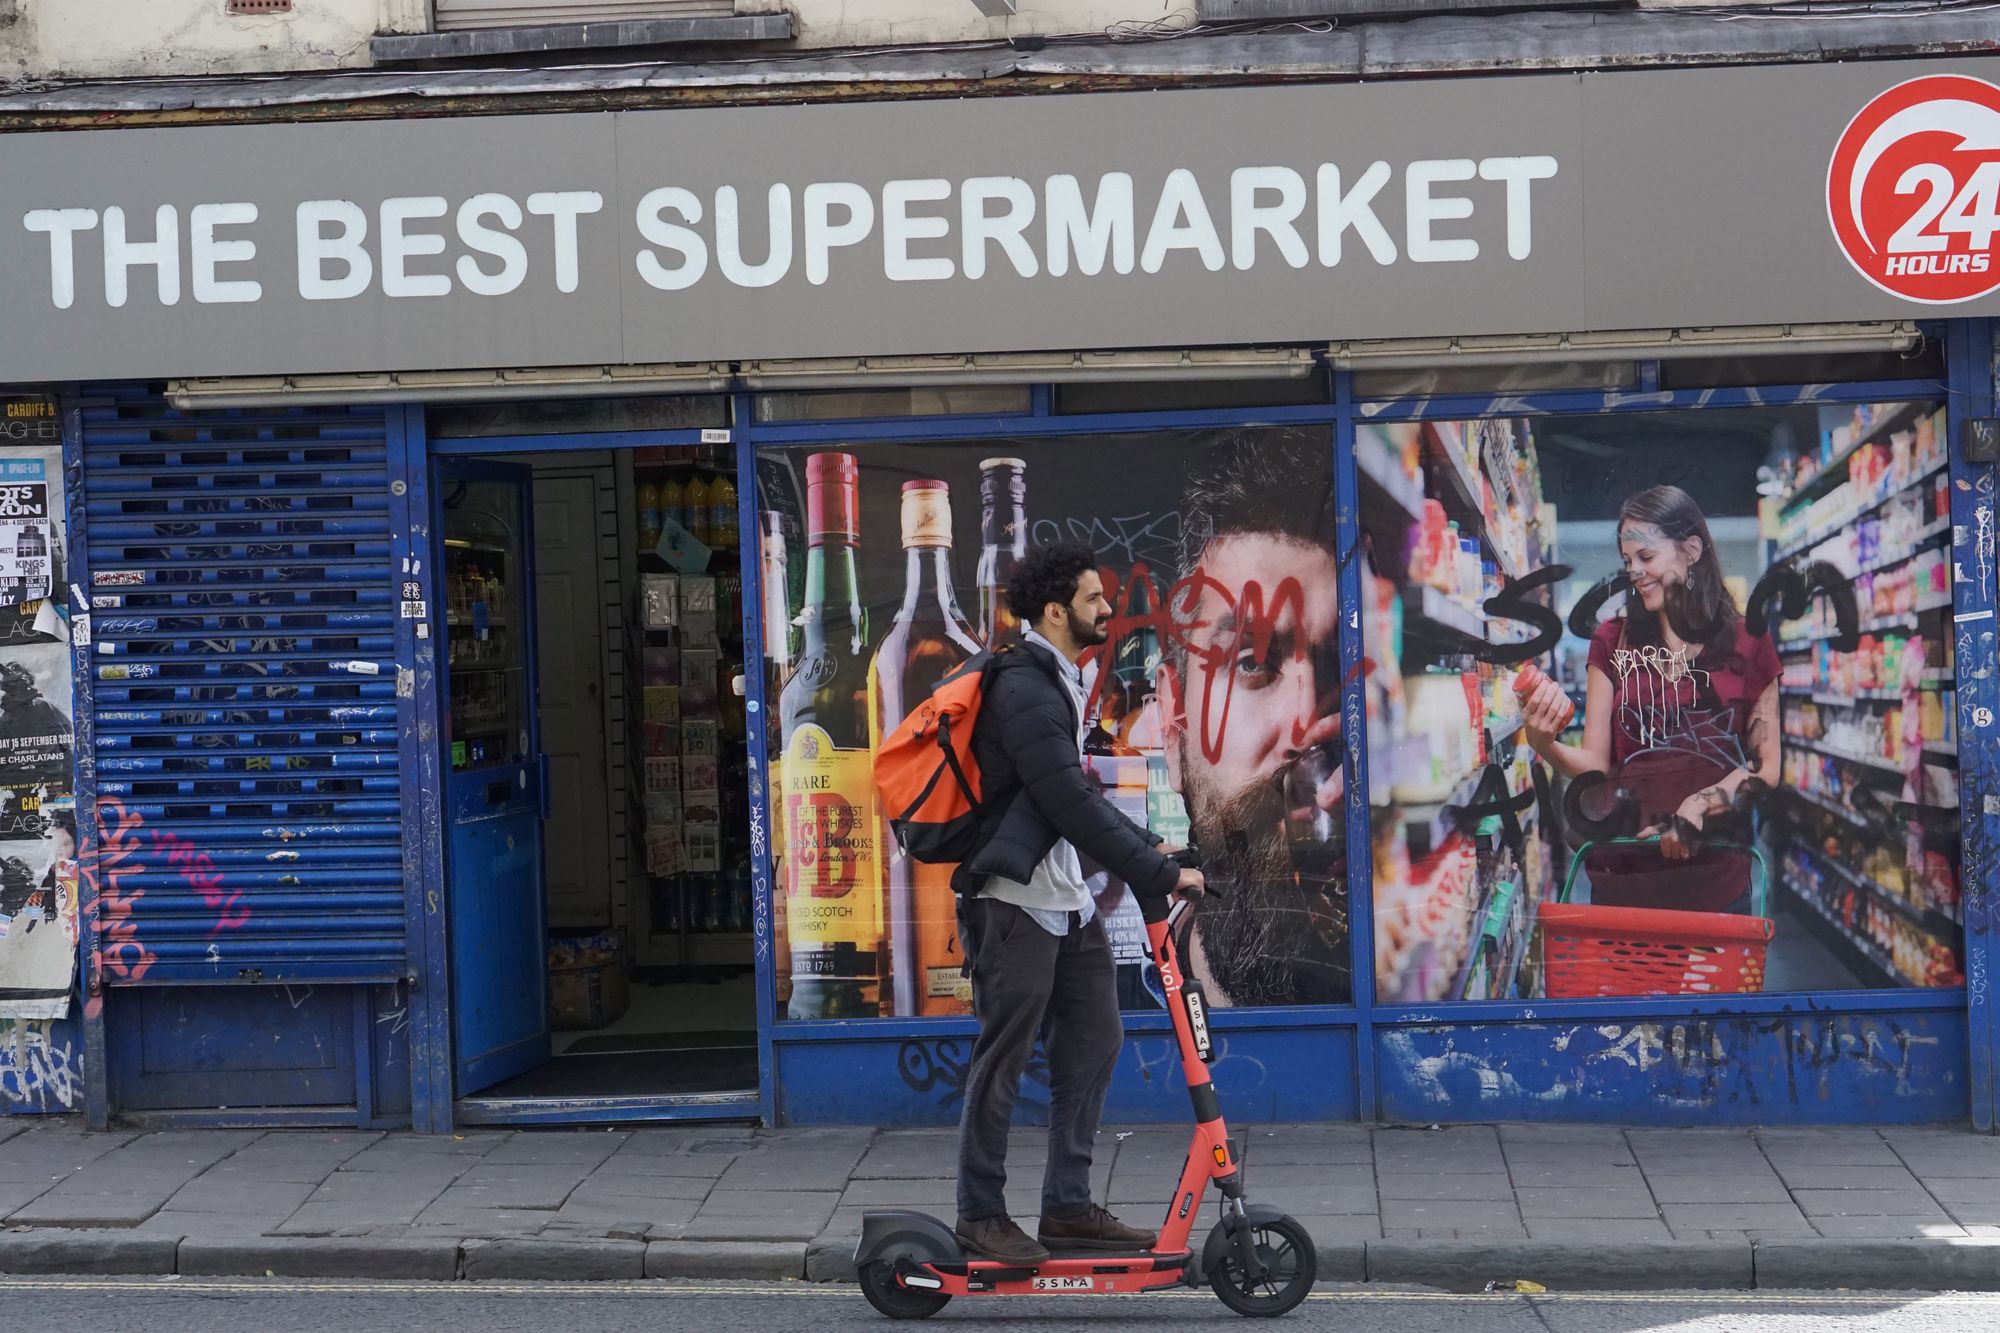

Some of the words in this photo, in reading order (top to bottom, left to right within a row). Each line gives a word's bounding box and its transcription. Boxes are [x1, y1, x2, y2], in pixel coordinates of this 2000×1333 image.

[1887, 161, 2000, 254] 24
[23, 203, 262, 309] THE
[297, 191, 603, 300] BEST
[636, 155, 1559, 291] SUPERMARKET
[1885, 253, 1990, 276] HOURS
[7, 403, 46, 417] CARDIFF
[15, 559, 45, 569] KINGS
[20, 734, 58, 747] SEPTEMBER
[8, 752, 65, 764] CHARLATANS
[793, 775, 831, 790] RARE
[811, 806, 828, 817] THE
[829, 805, 864, 817] PUREST
[812, 906, 853, 918] SCOTCH
[797, 920, 829, 932] WHISKY
[814, 960, 835, 971] 1749
[1160, 961, 1181, 998] voi.
